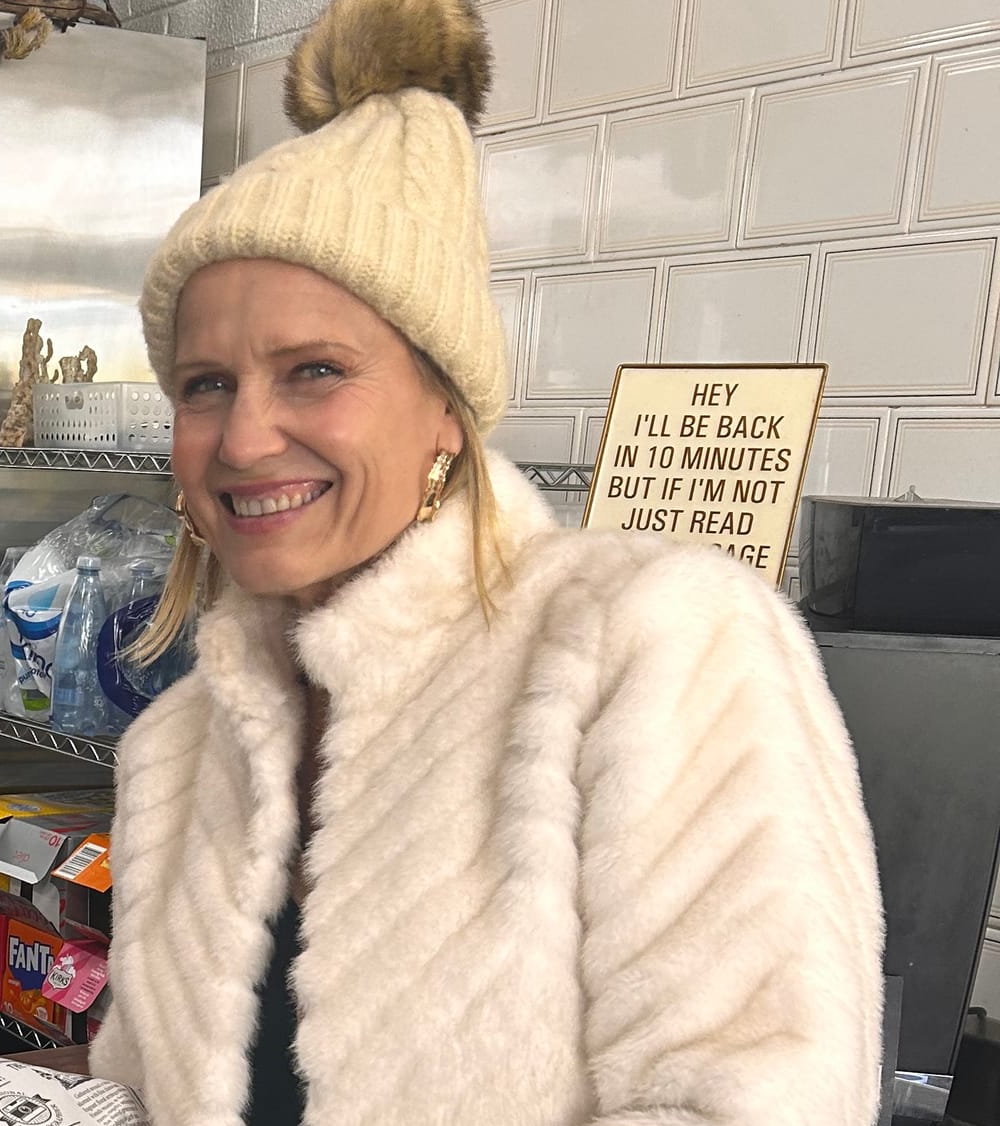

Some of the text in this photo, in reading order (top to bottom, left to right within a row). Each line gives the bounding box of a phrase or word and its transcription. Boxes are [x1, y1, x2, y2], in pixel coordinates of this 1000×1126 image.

[691, 383, 739, 407] HEY
[634, 414, 784, 439] I'LL BE BACK
[613, 445, 792, 472] IN 10 MINUTES
[607, 476, 785, 504] BUT IF I'M NOT
[621, 508, 754, 536] JUST READ
[51, 970, 70, 987] KIRKS
